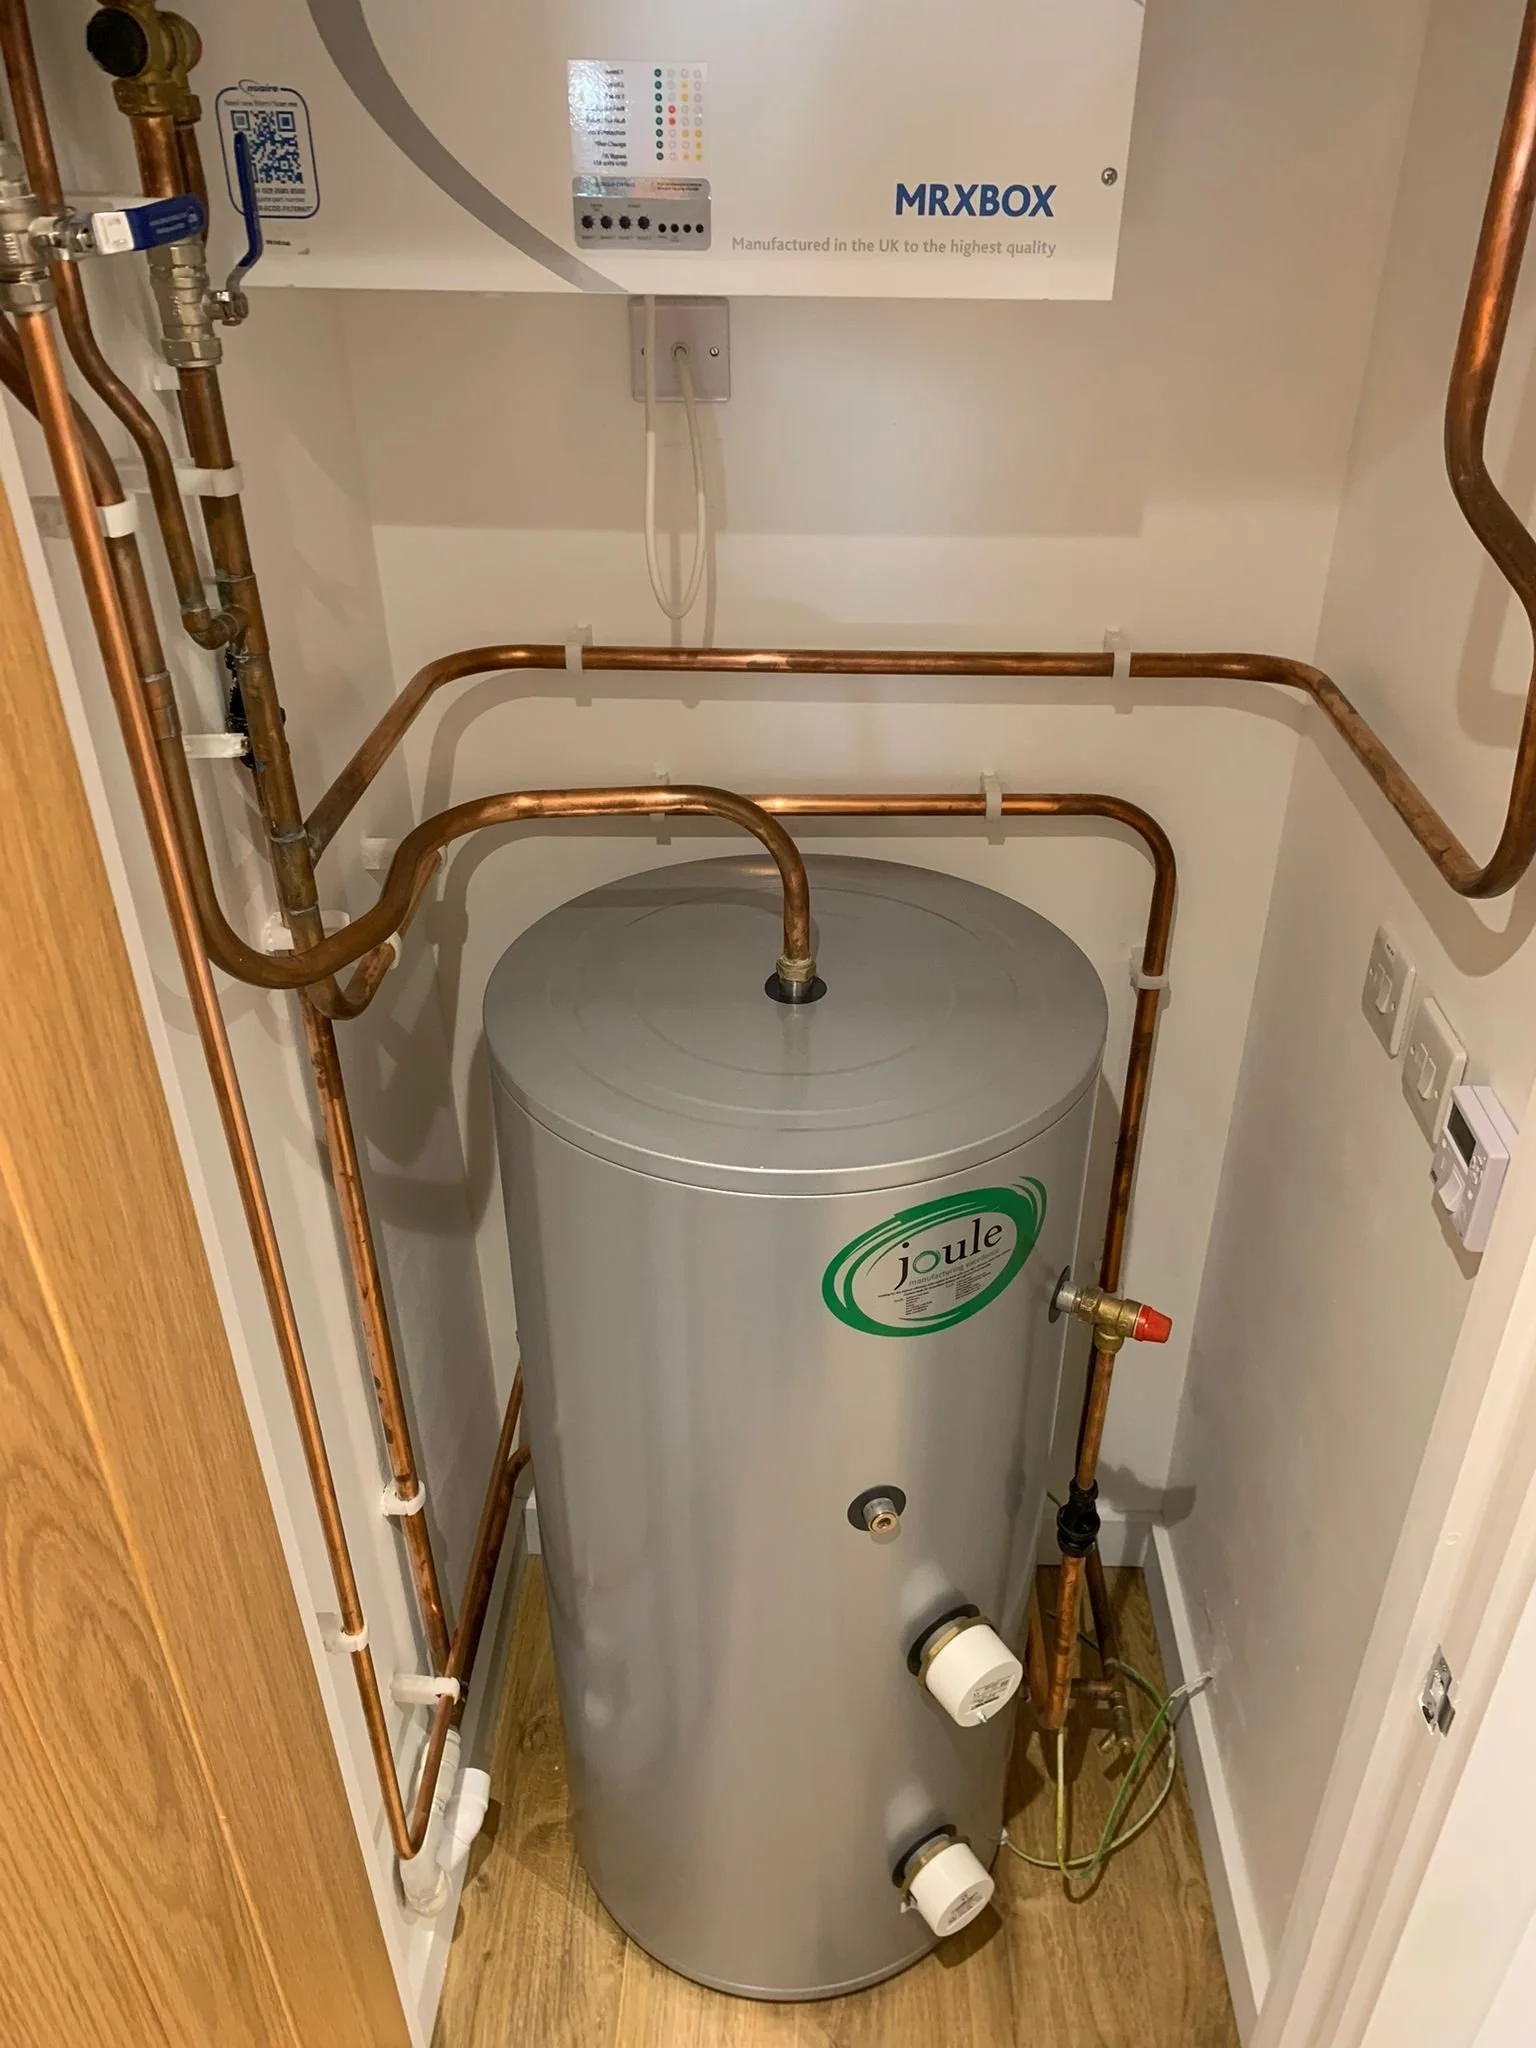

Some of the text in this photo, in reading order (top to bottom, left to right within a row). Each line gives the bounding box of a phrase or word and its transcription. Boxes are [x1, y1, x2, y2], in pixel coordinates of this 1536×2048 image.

[895, 183, 1057, 217] MRXBOX
[731, 236, 1057, 258] Manufactured in the UK to the highest quality
[894, 1218, 1003, 1291] joule
